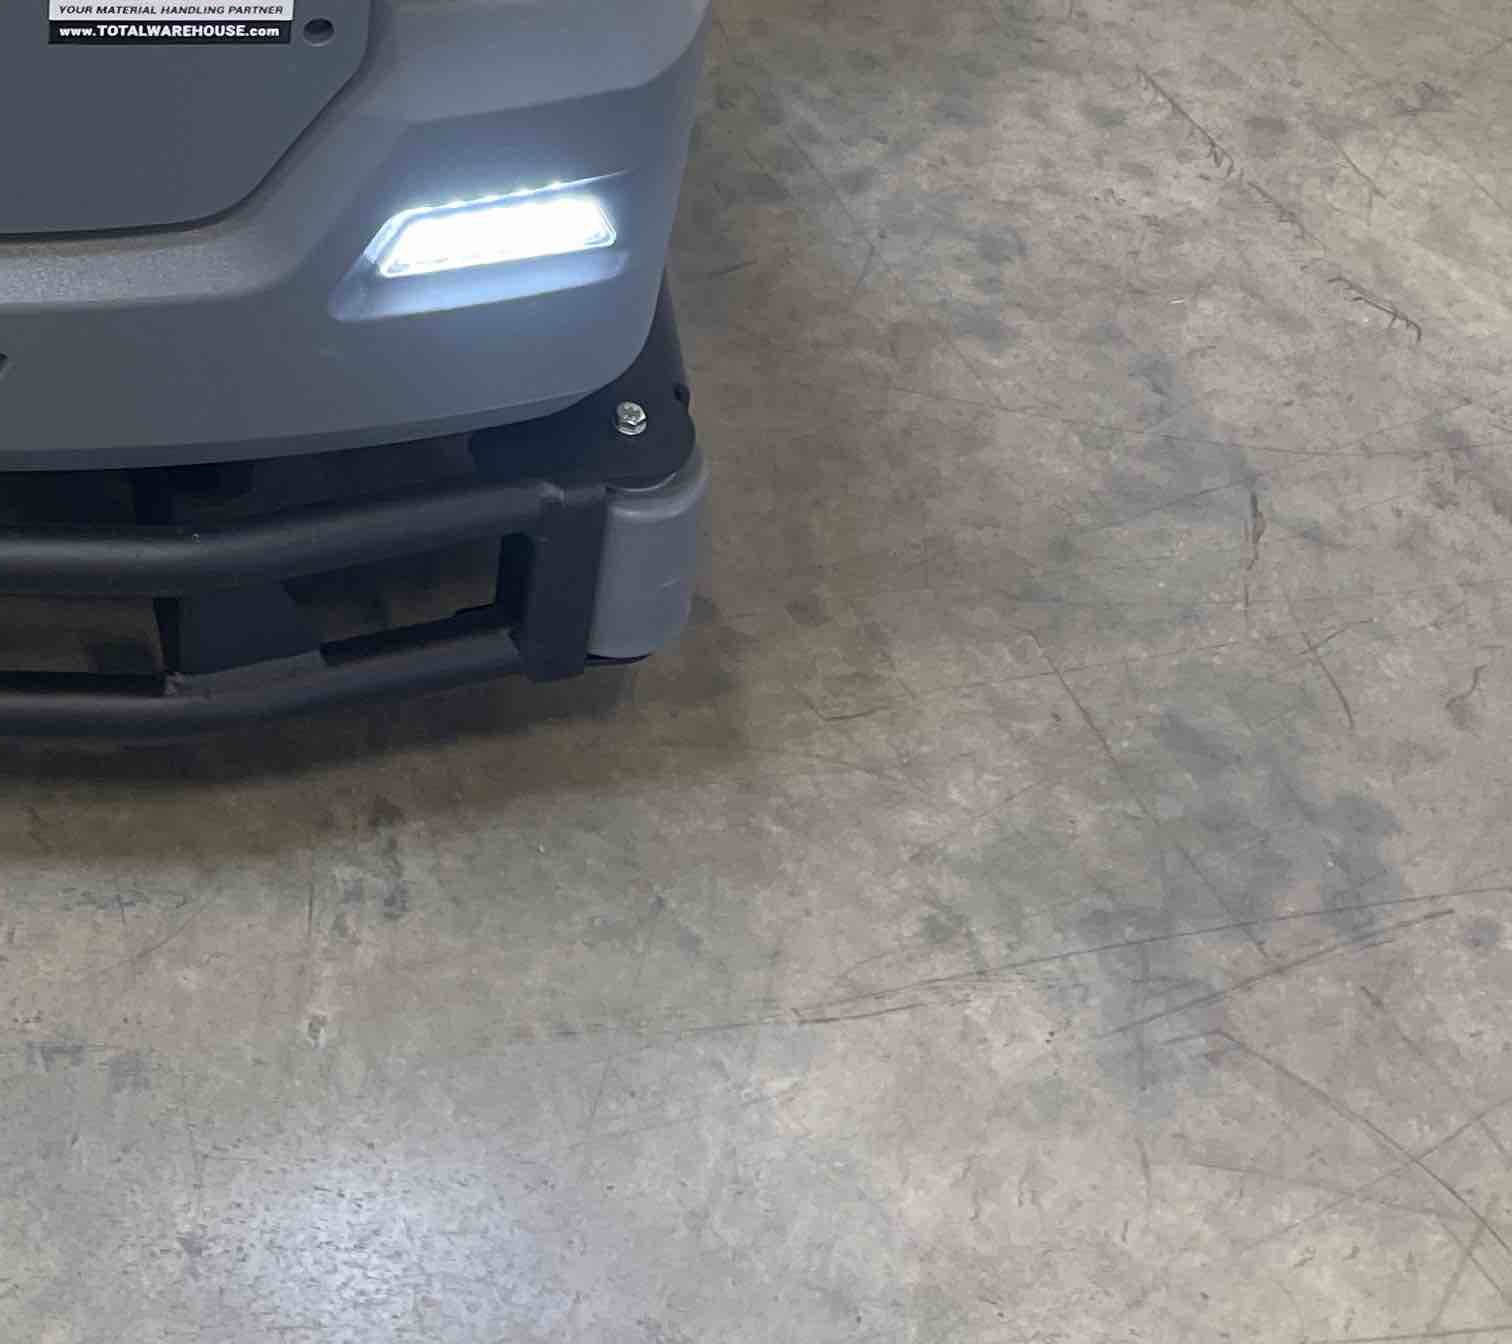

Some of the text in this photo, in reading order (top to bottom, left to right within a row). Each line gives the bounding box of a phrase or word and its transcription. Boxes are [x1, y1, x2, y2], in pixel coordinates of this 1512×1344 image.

[59, 5, 284, 15] YOUR MATERIAL HANDLING PARTNER
[59, 24, 281, 38] www.TOTALWAREHOUSE.com
